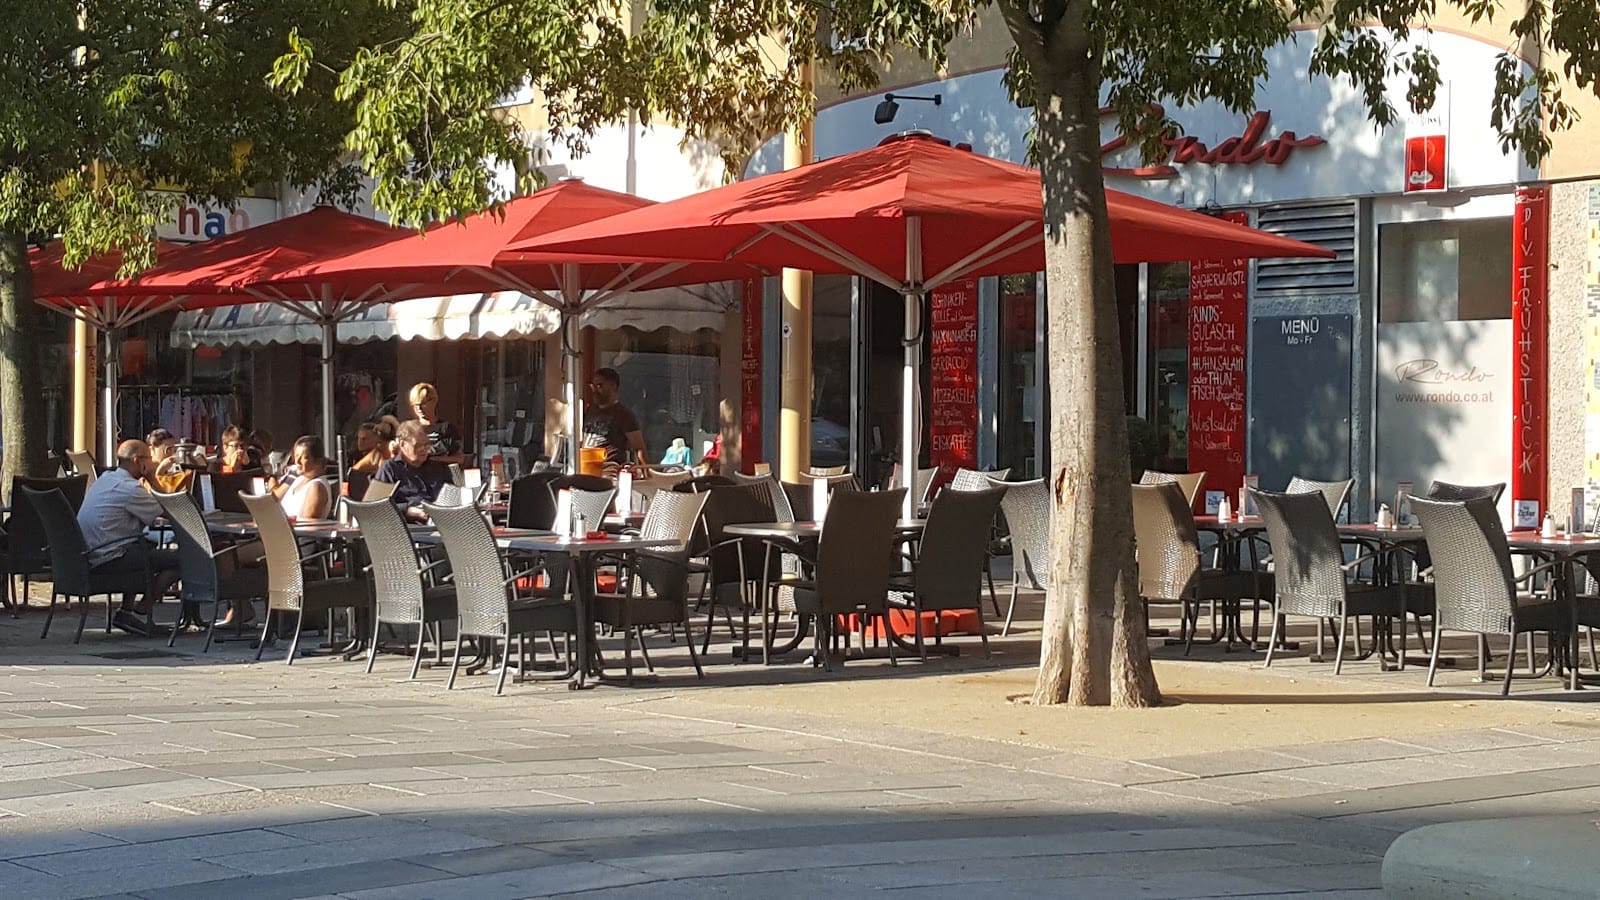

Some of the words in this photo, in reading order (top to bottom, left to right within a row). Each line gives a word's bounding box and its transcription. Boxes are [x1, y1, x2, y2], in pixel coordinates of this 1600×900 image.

[1192, 322, 1235, 342] GULASCH
[1281, 316, 1319, 334] MENÜ
[1304, 335, 1313, 345] Fr
[1395, 358, 1495, 384] Rondo
[1517, 266, 1535, 474] FRÜHSTÜCK
[1395, 391, 1494, 403] www.rondo.co.at
